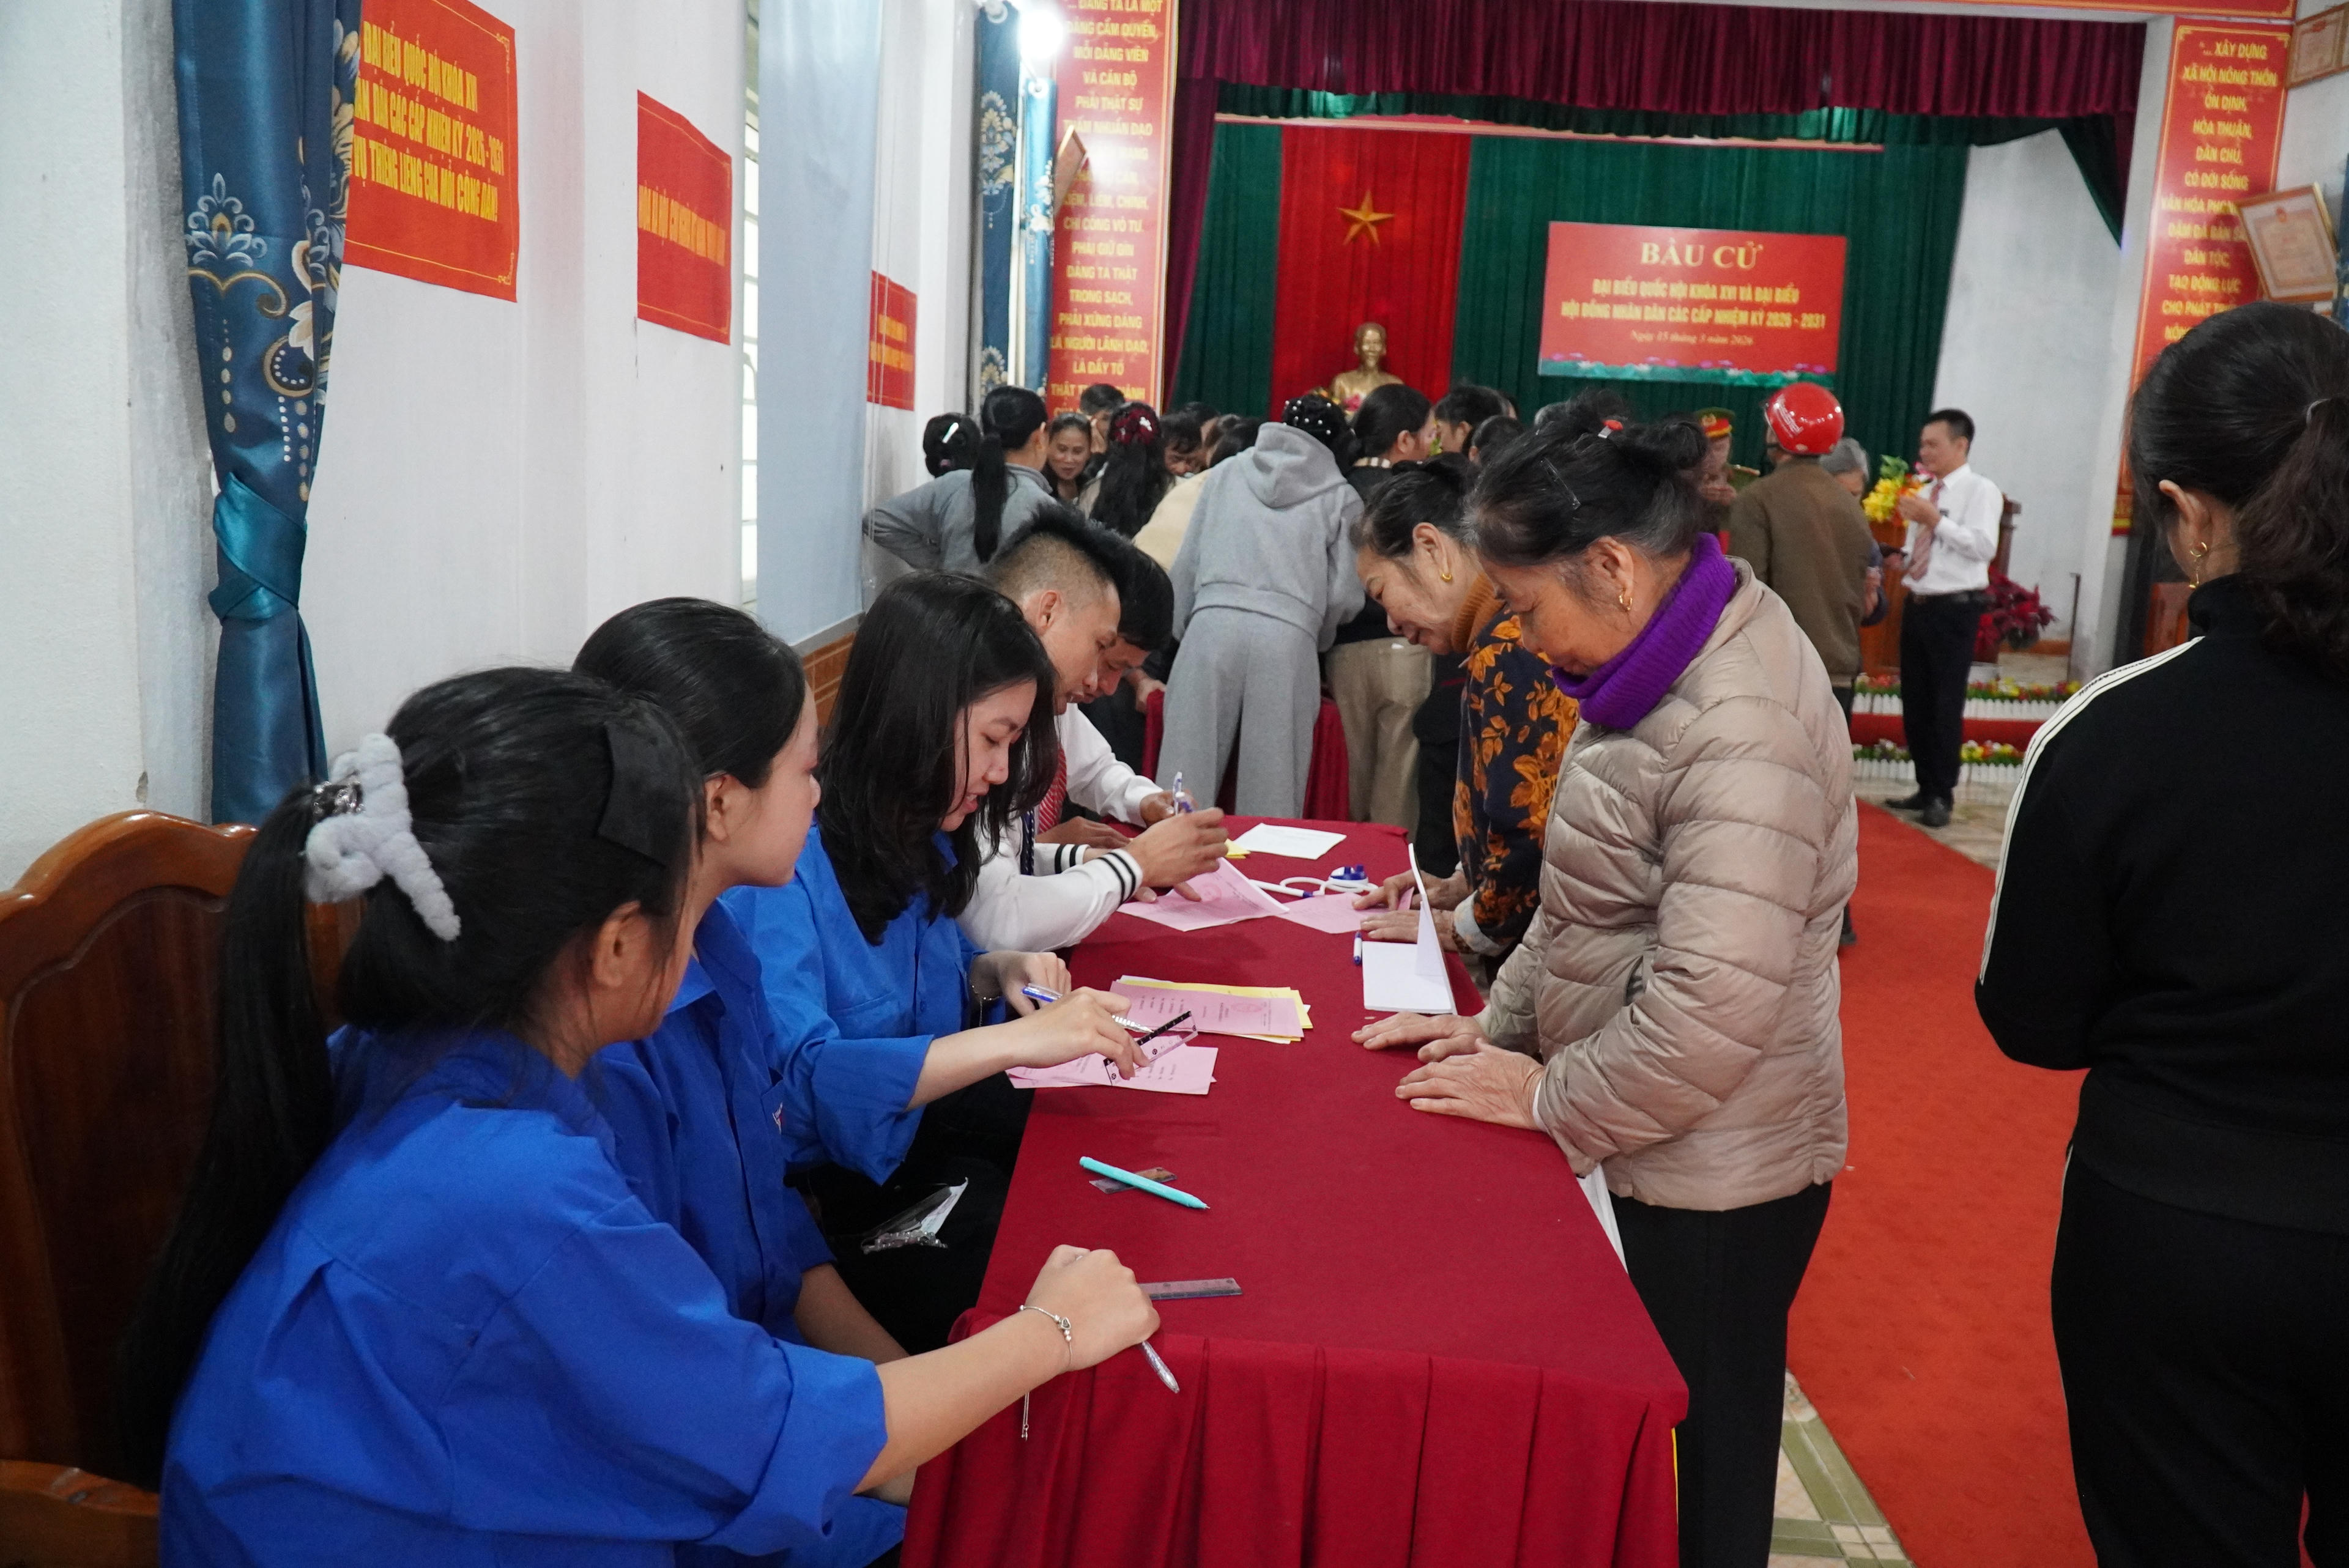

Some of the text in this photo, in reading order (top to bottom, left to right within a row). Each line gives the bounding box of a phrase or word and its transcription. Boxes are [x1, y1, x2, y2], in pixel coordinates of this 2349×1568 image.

[1094, 42, 1124, 61] ĐẢNG
[1125, 45, 1149, 62] VIÊN
[2214, 39, 2236, 57] XÂY
[404, 34, 427, 89] QUỐC
[1083, 68, 1097, 84] VÀ
[1099, 68, 1121, 86] CÁN
[2183, 62, 2278, 87] XÃ HỘI NÔNG THÔN
[390, 88, 407, 138] CÁC
[2196, 143, 2217, 161] DÂN
[2184, 169, 2200, 187] CÓ
[2207, 199, 2240, 215] PHON
[1641, 237, 1764, 269] BẦU CỬ
[2184, 247, 2206, 265] DÂN
[1097, 266, 1110, 279] TA
[1113, 265, 1138, 283] THẬT
[1592, 278, 1612, 297] ĐẠI
[1612, 275, 1638, 296] BIỂU
[1069, 289, 1102, 303] TRONG
[1561, 298, 1579, 319] HỘI
[1643, 303, 1666, 322] DÂN
[1668, 305, 1690, 322] CÁC
[1691, 305, 1713, 323] CẤP
[1073, 358, 1086, 374] LÀ
